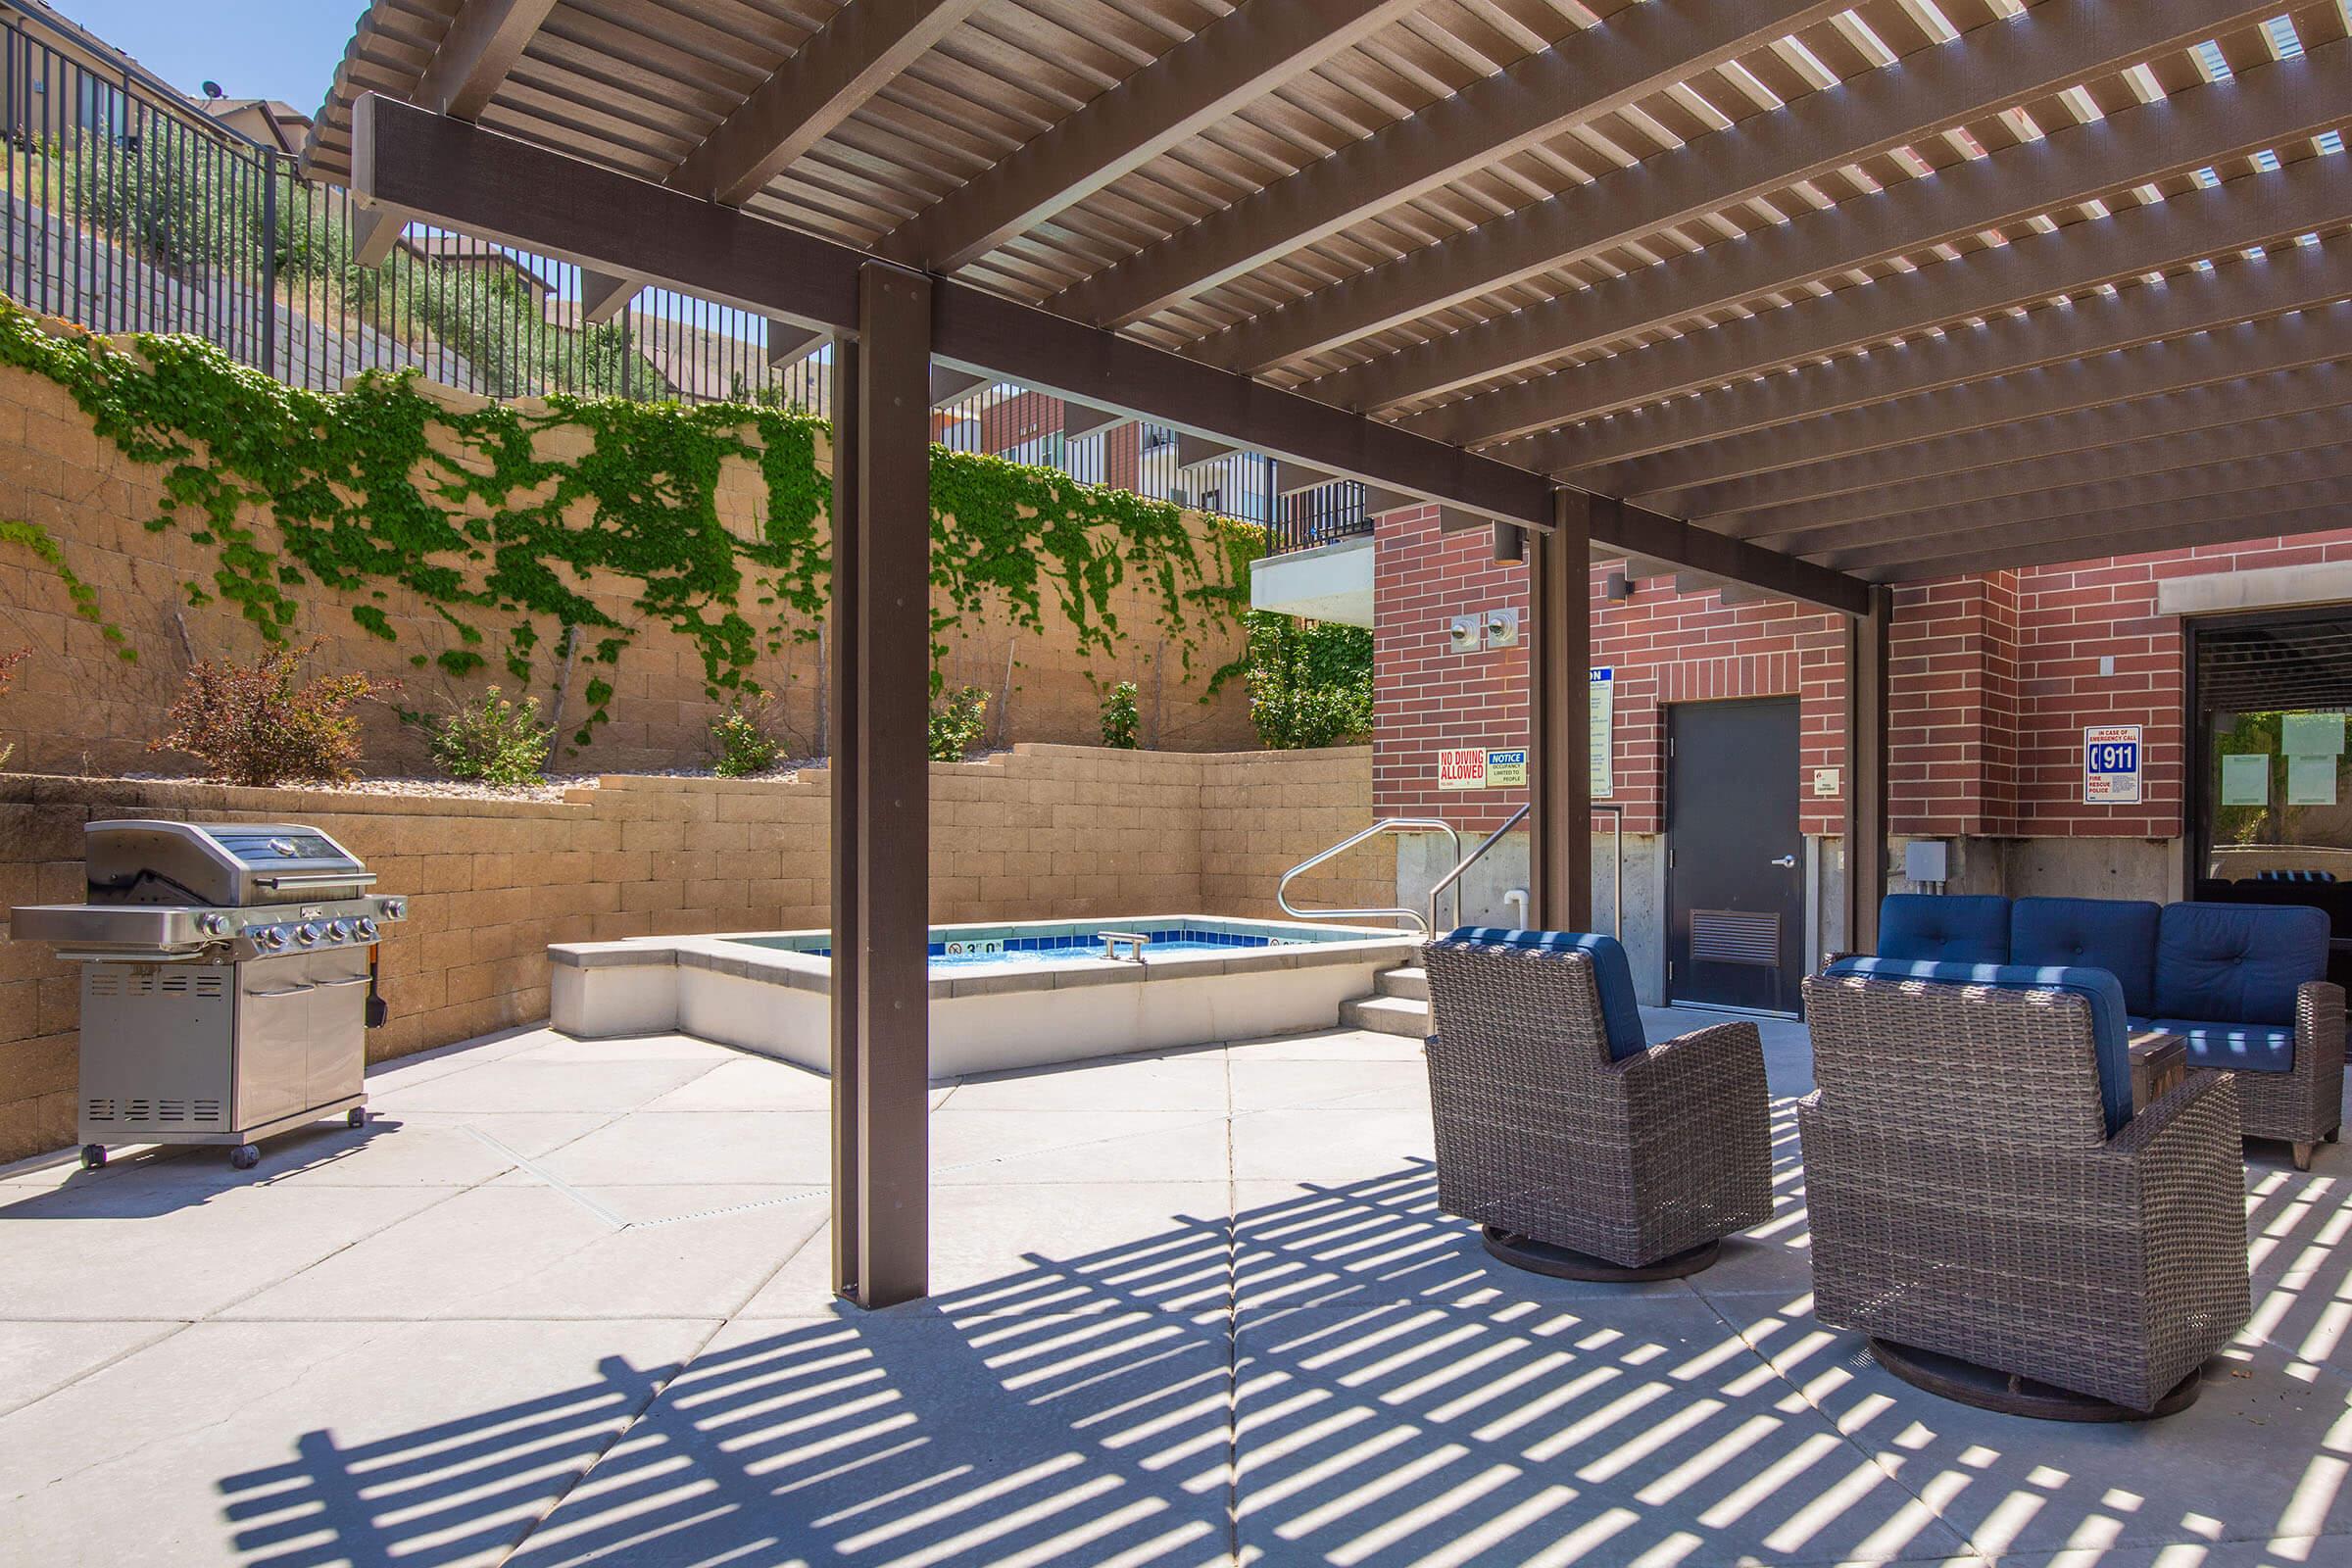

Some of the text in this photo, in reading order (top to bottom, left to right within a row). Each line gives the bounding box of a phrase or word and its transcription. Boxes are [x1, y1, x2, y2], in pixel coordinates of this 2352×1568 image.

[1441, 751, 1484, 765] NO DIVING
[1493, 754, 1521, 762] NOTICE
[2103, 746, 2132, 769] 911
[1441, 765, 1484, 779] ALLOWED
